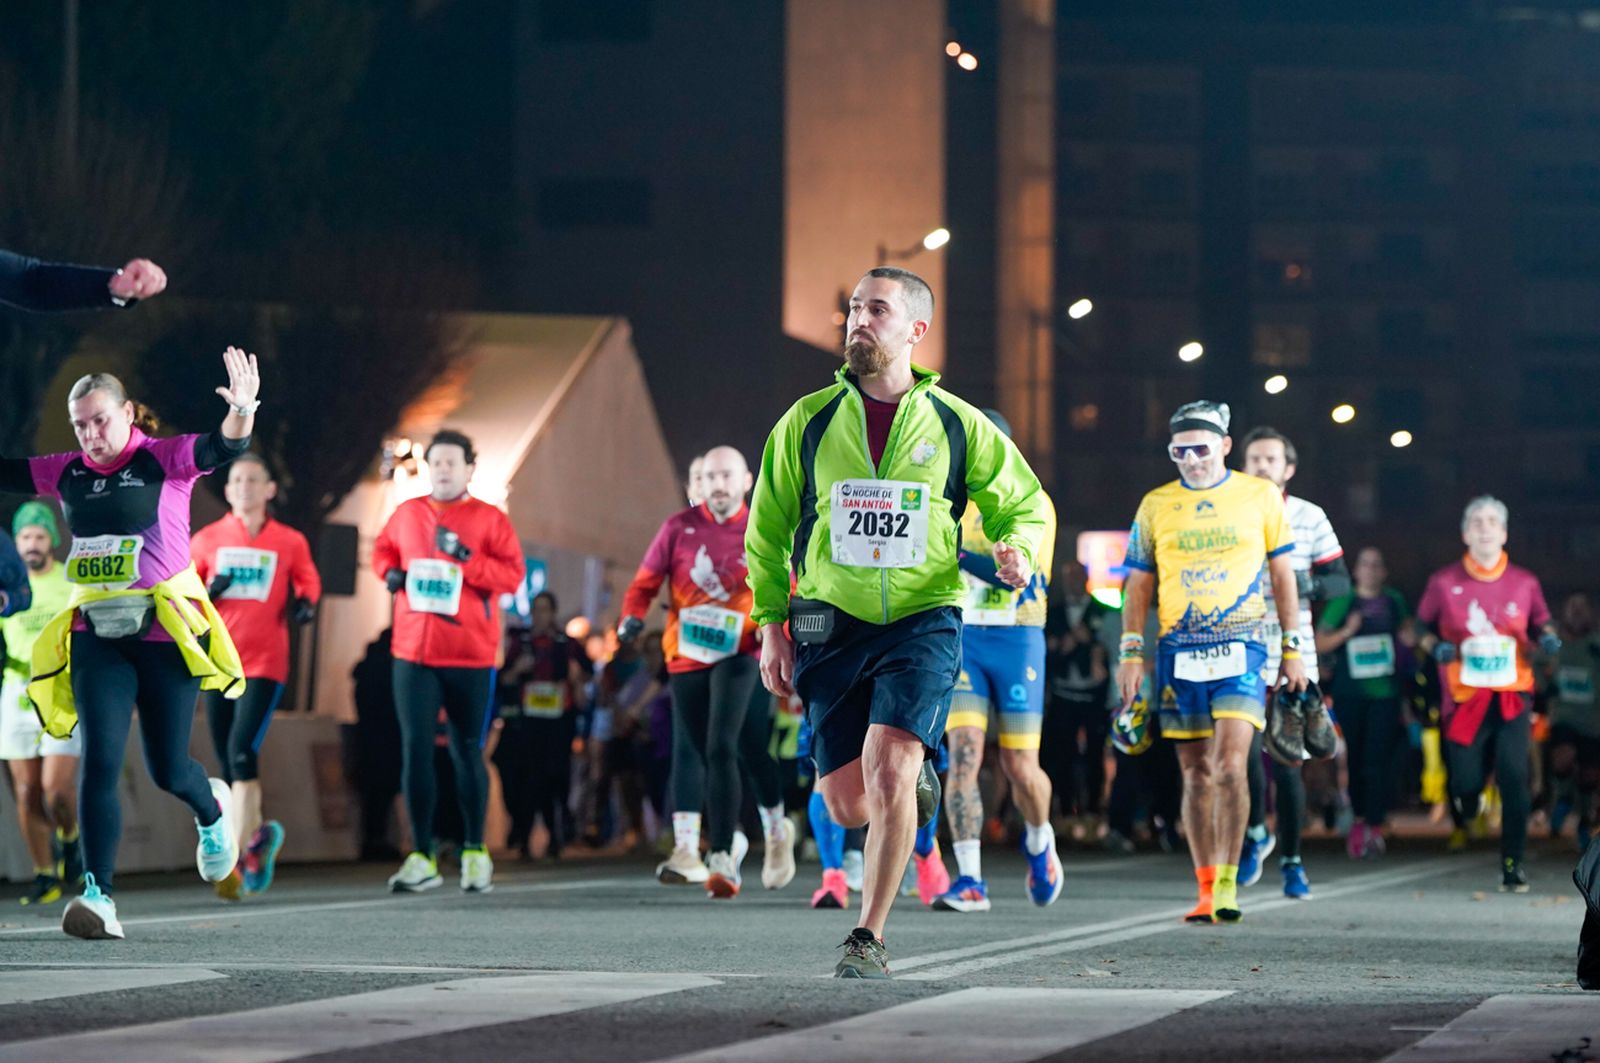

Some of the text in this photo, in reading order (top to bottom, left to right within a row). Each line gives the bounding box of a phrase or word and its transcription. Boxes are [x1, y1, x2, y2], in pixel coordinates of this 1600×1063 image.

[852, 488, 894, 499] NOCHE DE
[842, 498, 860, 508] SAN
[861, 497, 893, 510] ANTÓN
[848, 510, 910, 538] 2032
[1178, 535, 1239, 551] ALBAIDA
[77, 555, 125, 578] 6682
